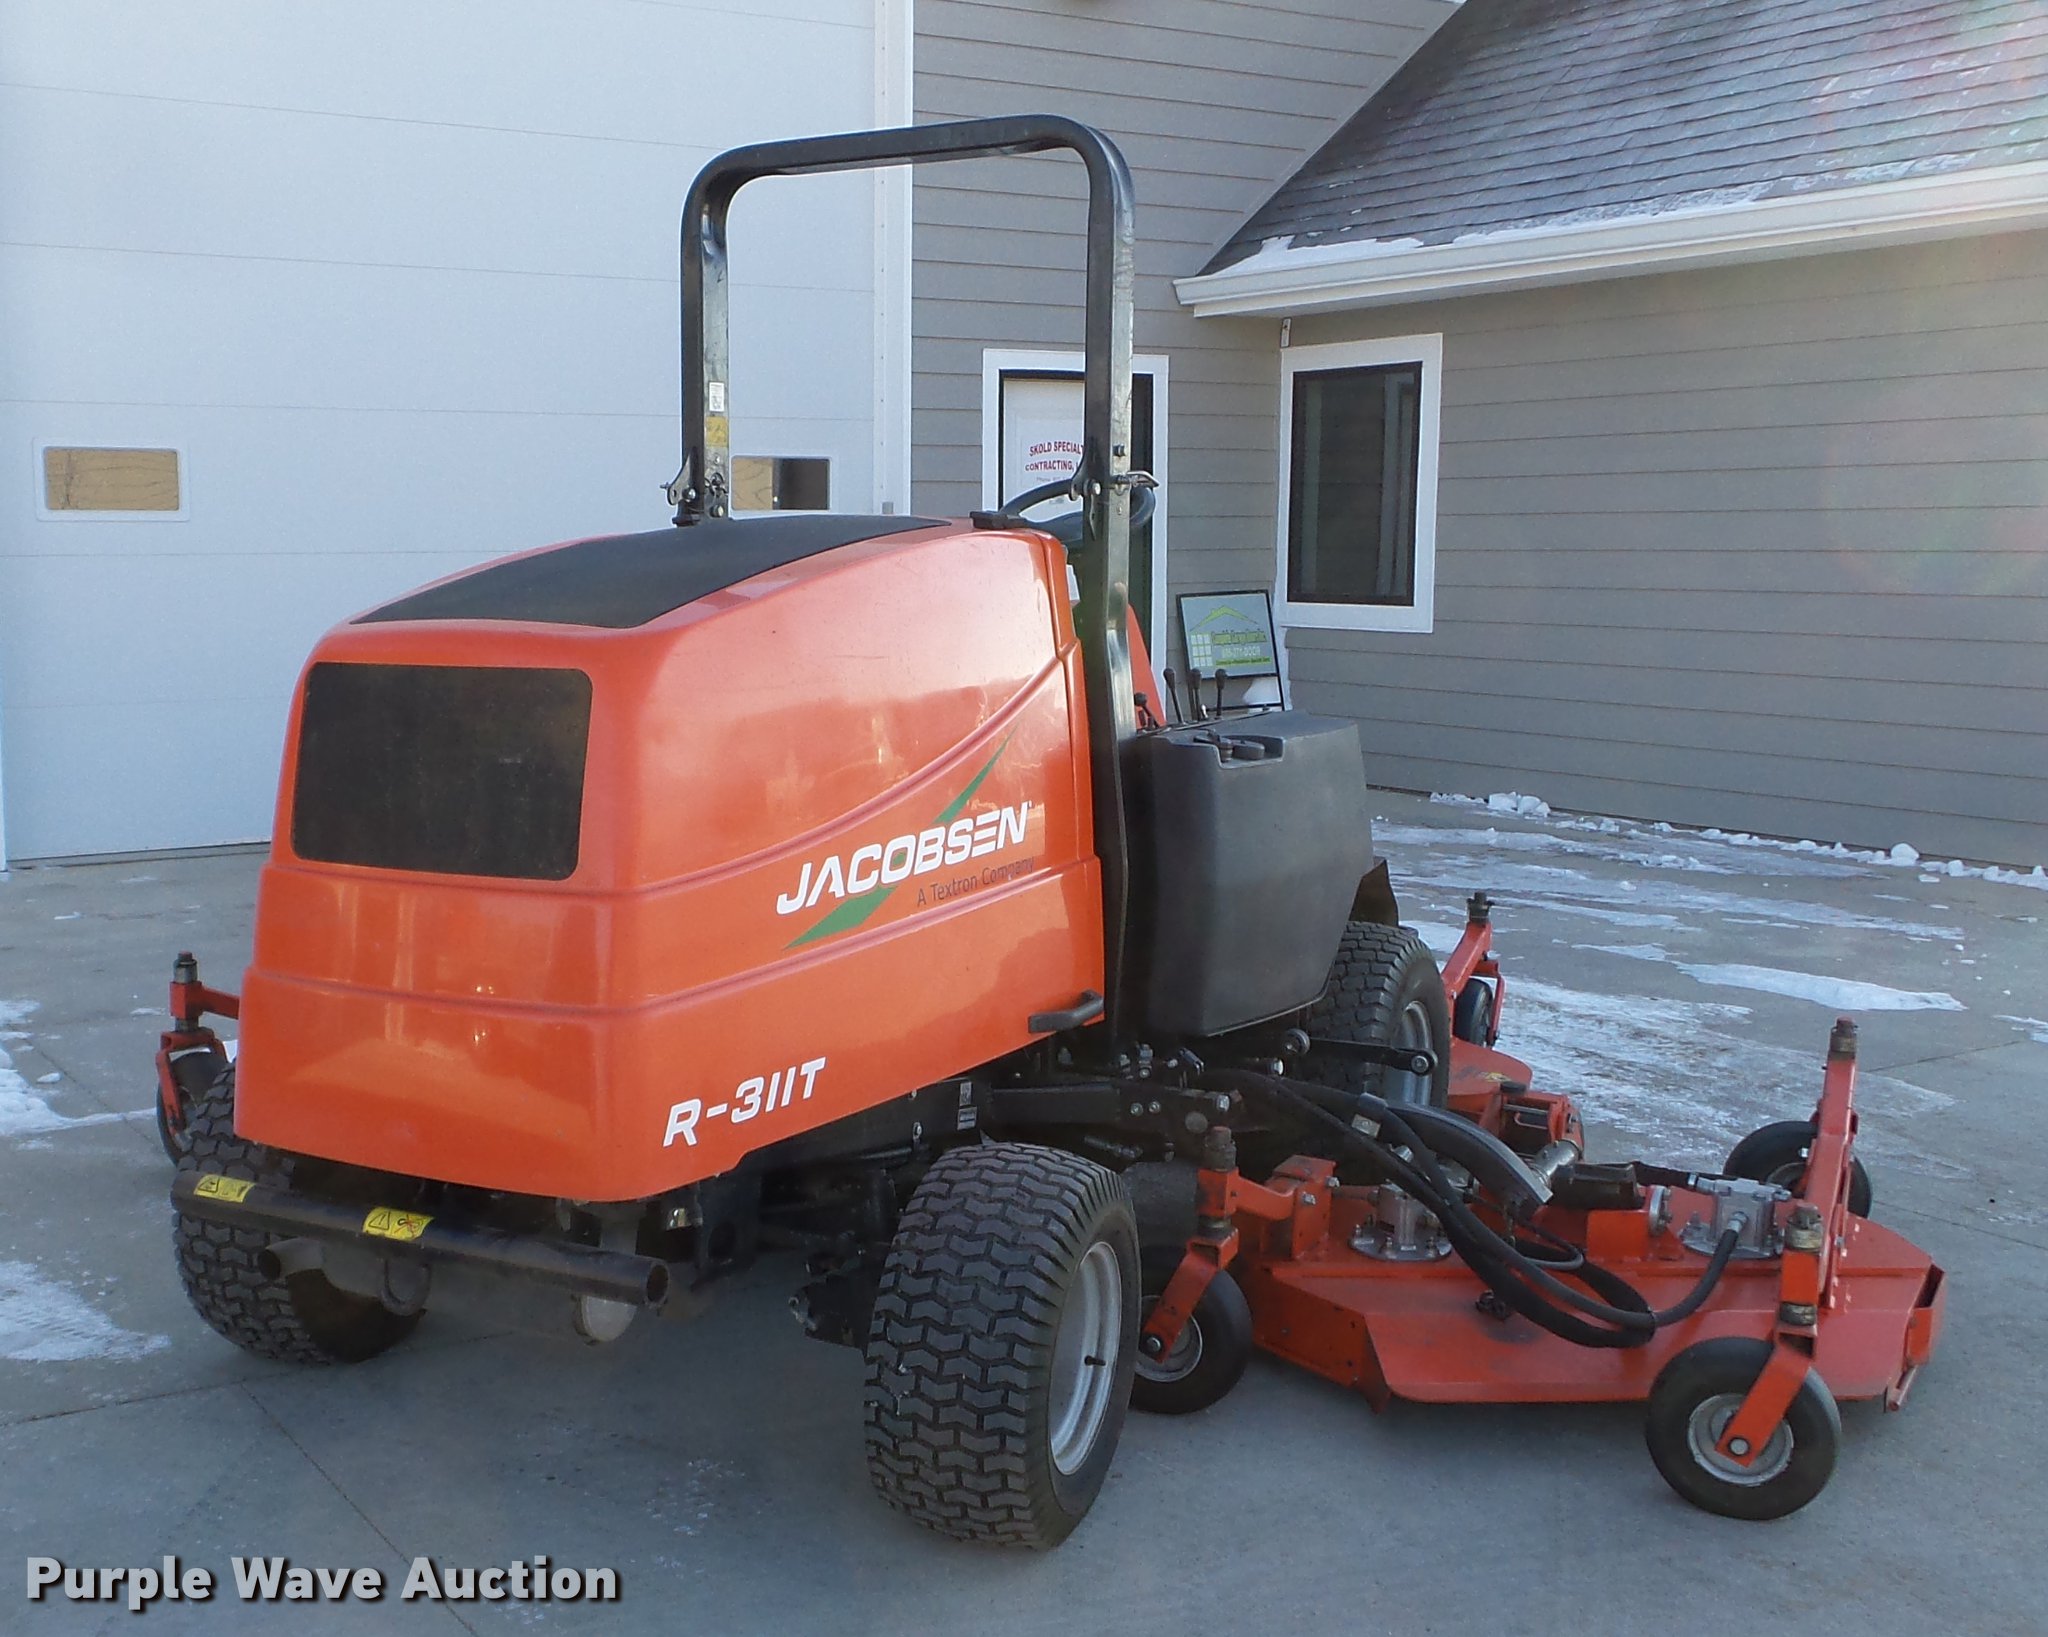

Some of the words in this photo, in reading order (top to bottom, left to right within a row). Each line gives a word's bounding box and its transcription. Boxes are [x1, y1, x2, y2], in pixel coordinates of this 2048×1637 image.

[1029, 441, 1052, 457] SKOLD
[776, 801, 1032, 915] JACOBSEN
[917, 888, 927, 907] A
[930, 871, 978, 901] Textron
[982, 856, 1035, 885] Company
[662, 1056, 826, 1147] R-311T
